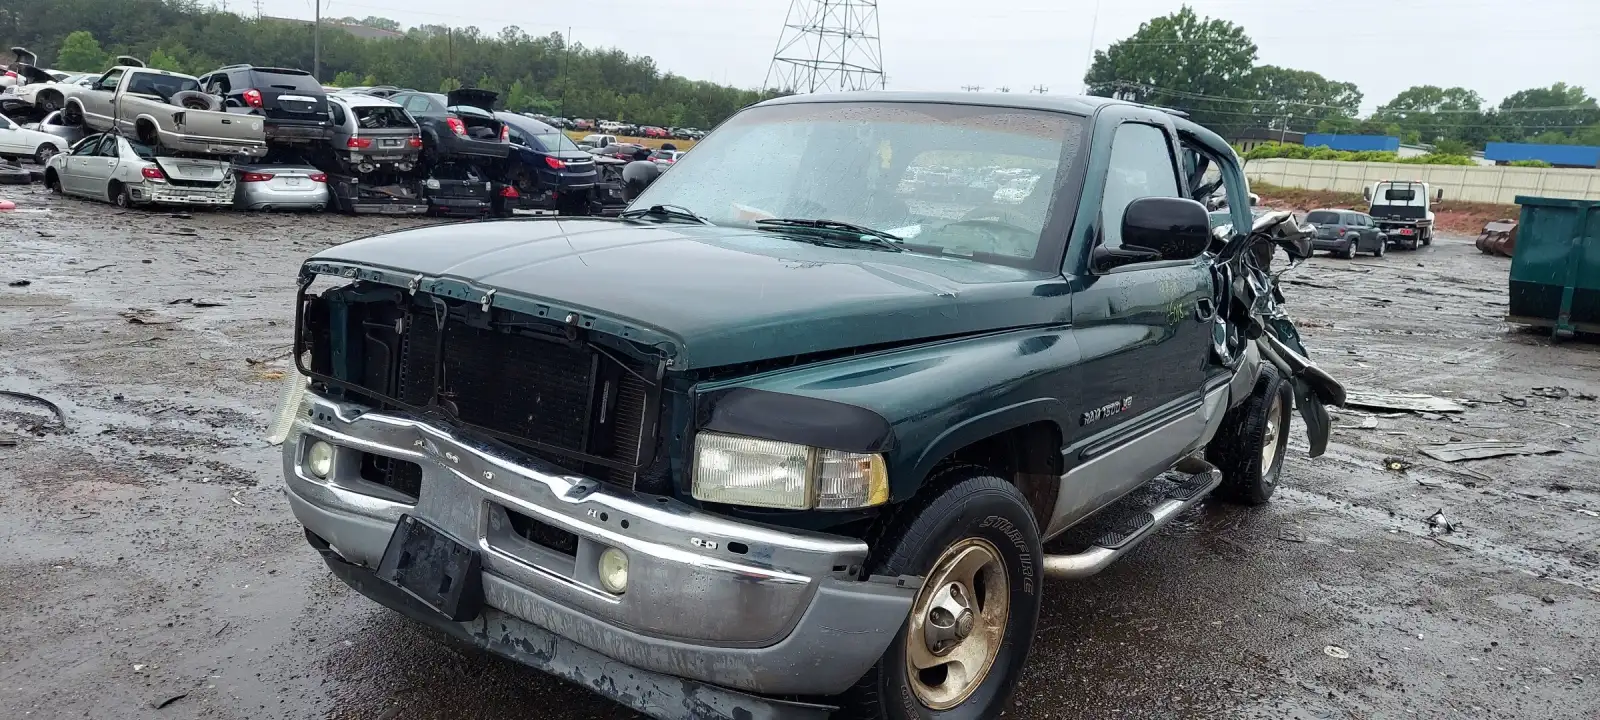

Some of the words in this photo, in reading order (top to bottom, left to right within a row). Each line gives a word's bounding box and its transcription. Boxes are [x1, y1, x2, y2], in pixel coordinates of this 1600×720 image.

[1084, 407, 1101, 425] RAM
[1101, 400, 1121, 419] 1500
[979, 515, 1034, 596] STARFIRE
